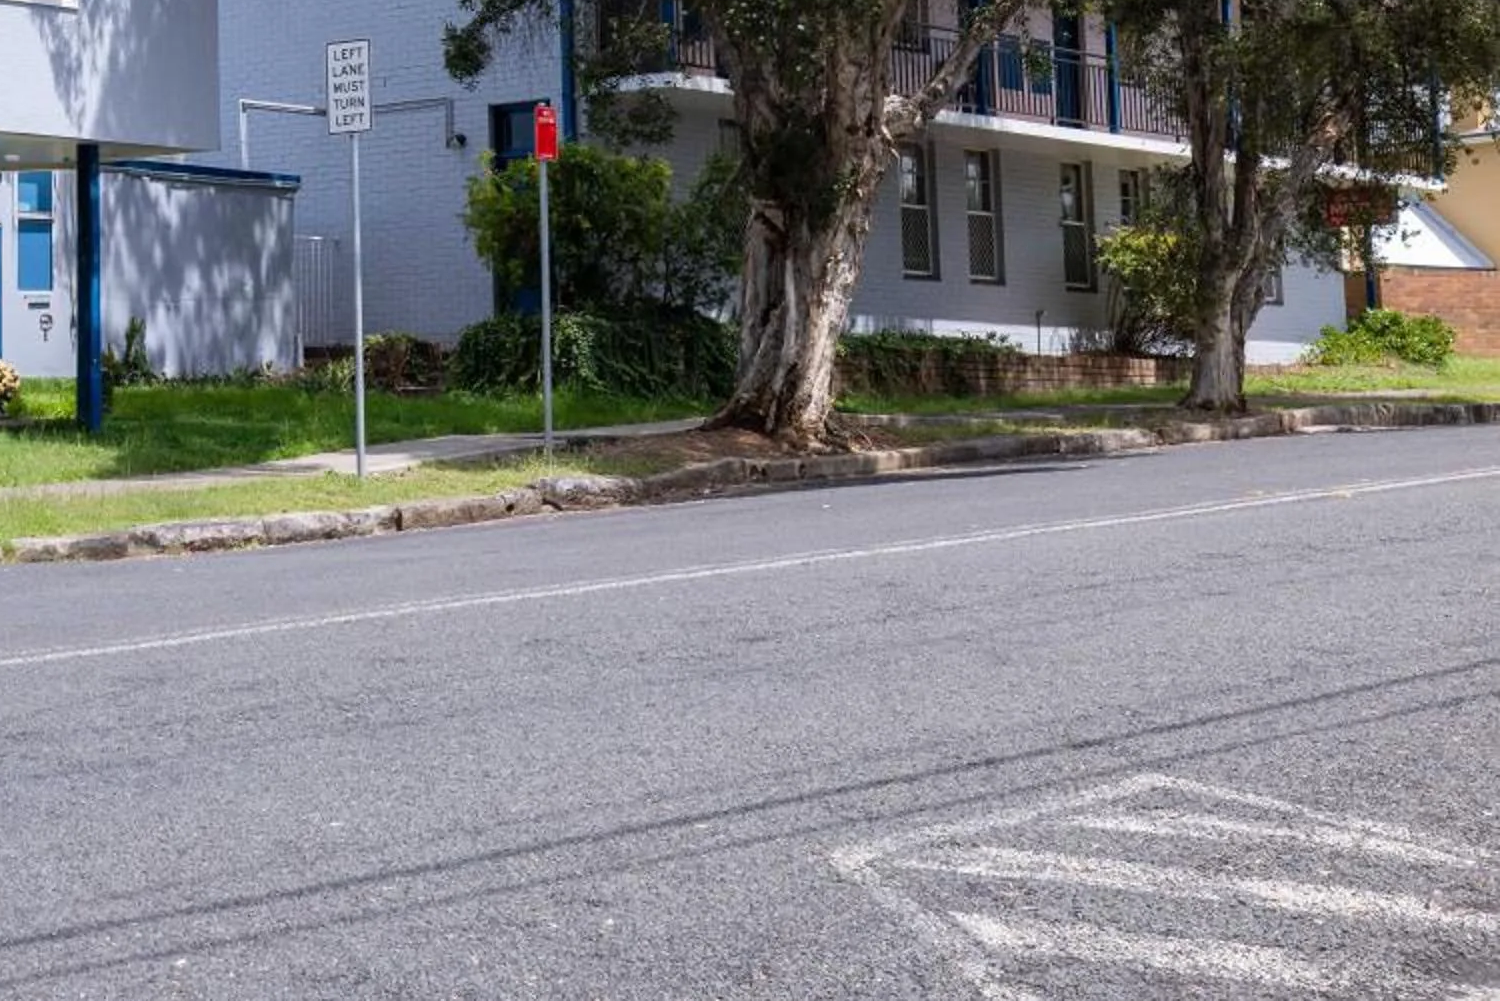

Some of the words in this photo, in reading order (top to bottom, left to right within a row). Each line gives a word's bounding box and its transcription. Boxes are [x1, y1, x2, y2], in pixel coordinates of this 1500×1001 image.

[333, 46, 363, 61] LEFT
[332, 62, 365, 78] LANE
[333, 79, 365, 94] MUST
[333, 95, 365, 110] TURN
[335, 112, 365, 127] LEFT
